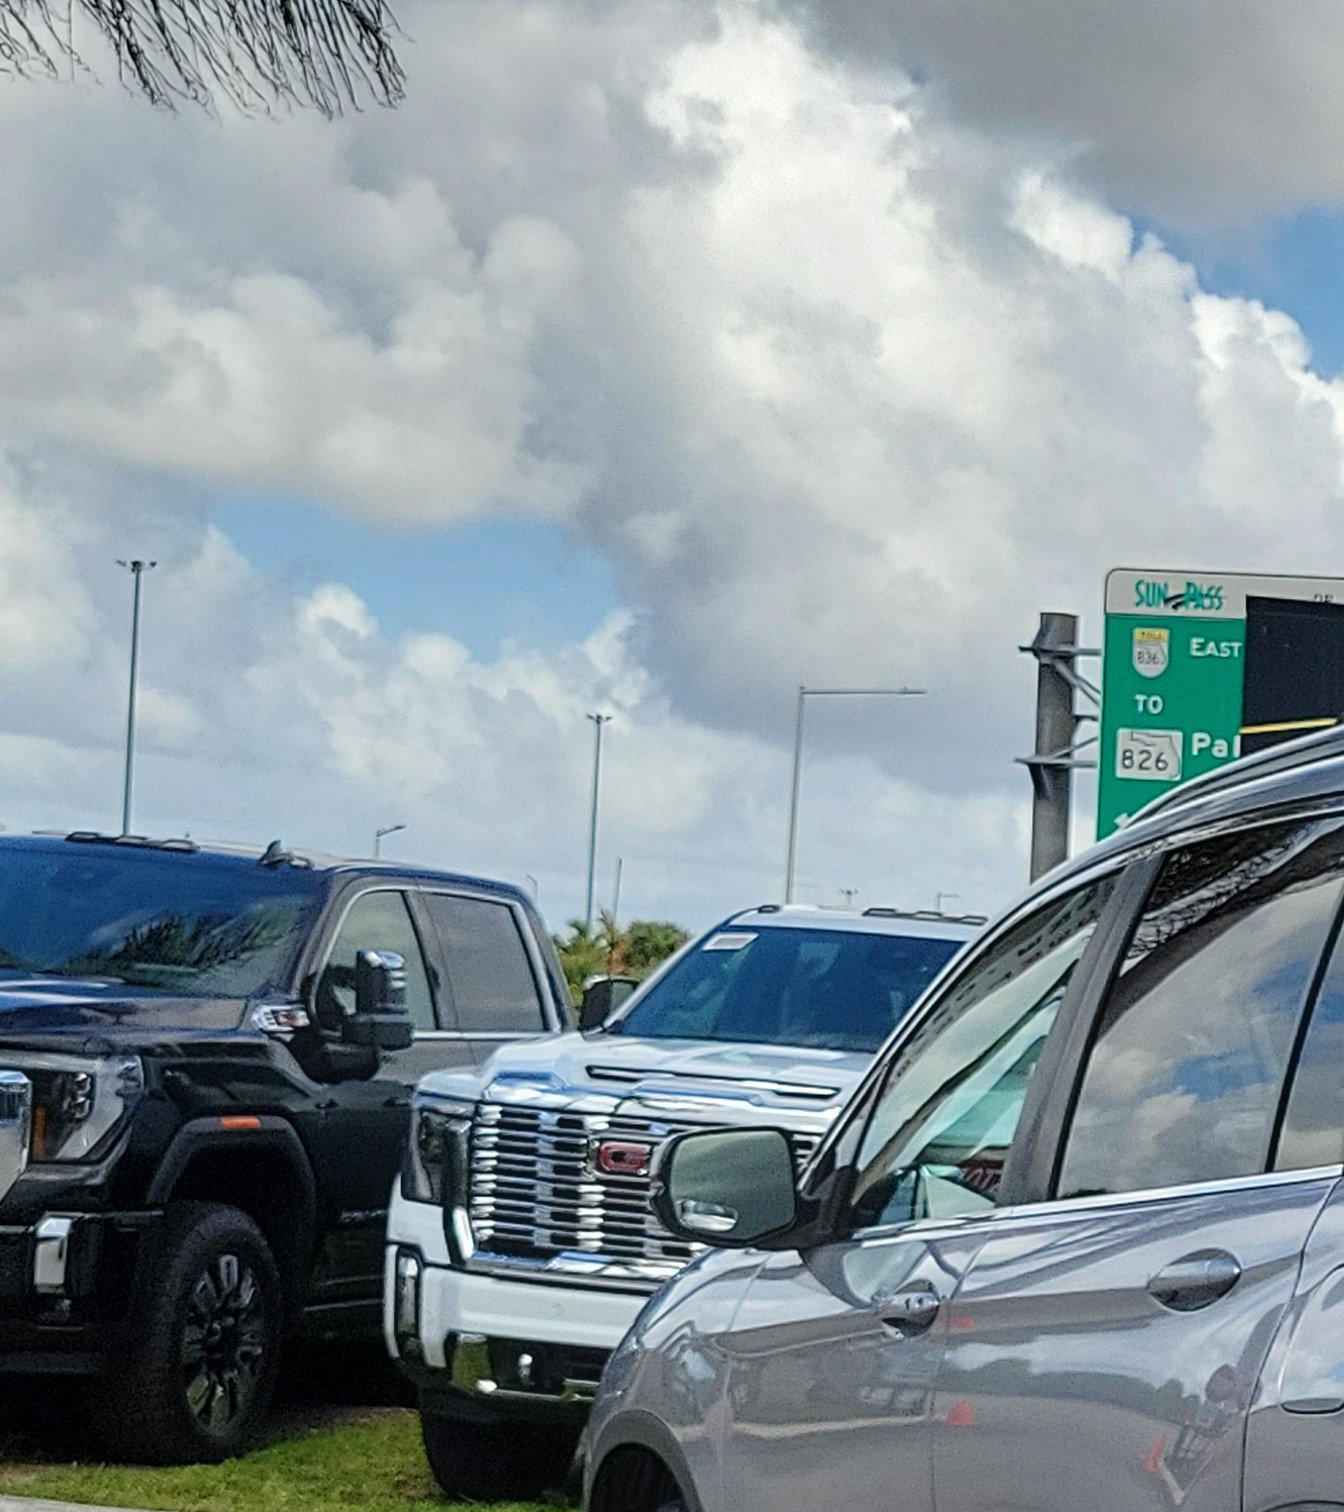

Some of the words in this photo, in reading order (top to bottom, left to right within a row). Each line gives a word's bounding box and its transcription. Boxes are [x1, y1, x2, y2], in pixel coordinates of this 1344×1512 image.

[1137, 649, 1160, 665] 836
[1189, 637, 1242, 658] EAST
[1134, 693, 1163, 715] TO
[1121, 749, 1169, 771] 826
